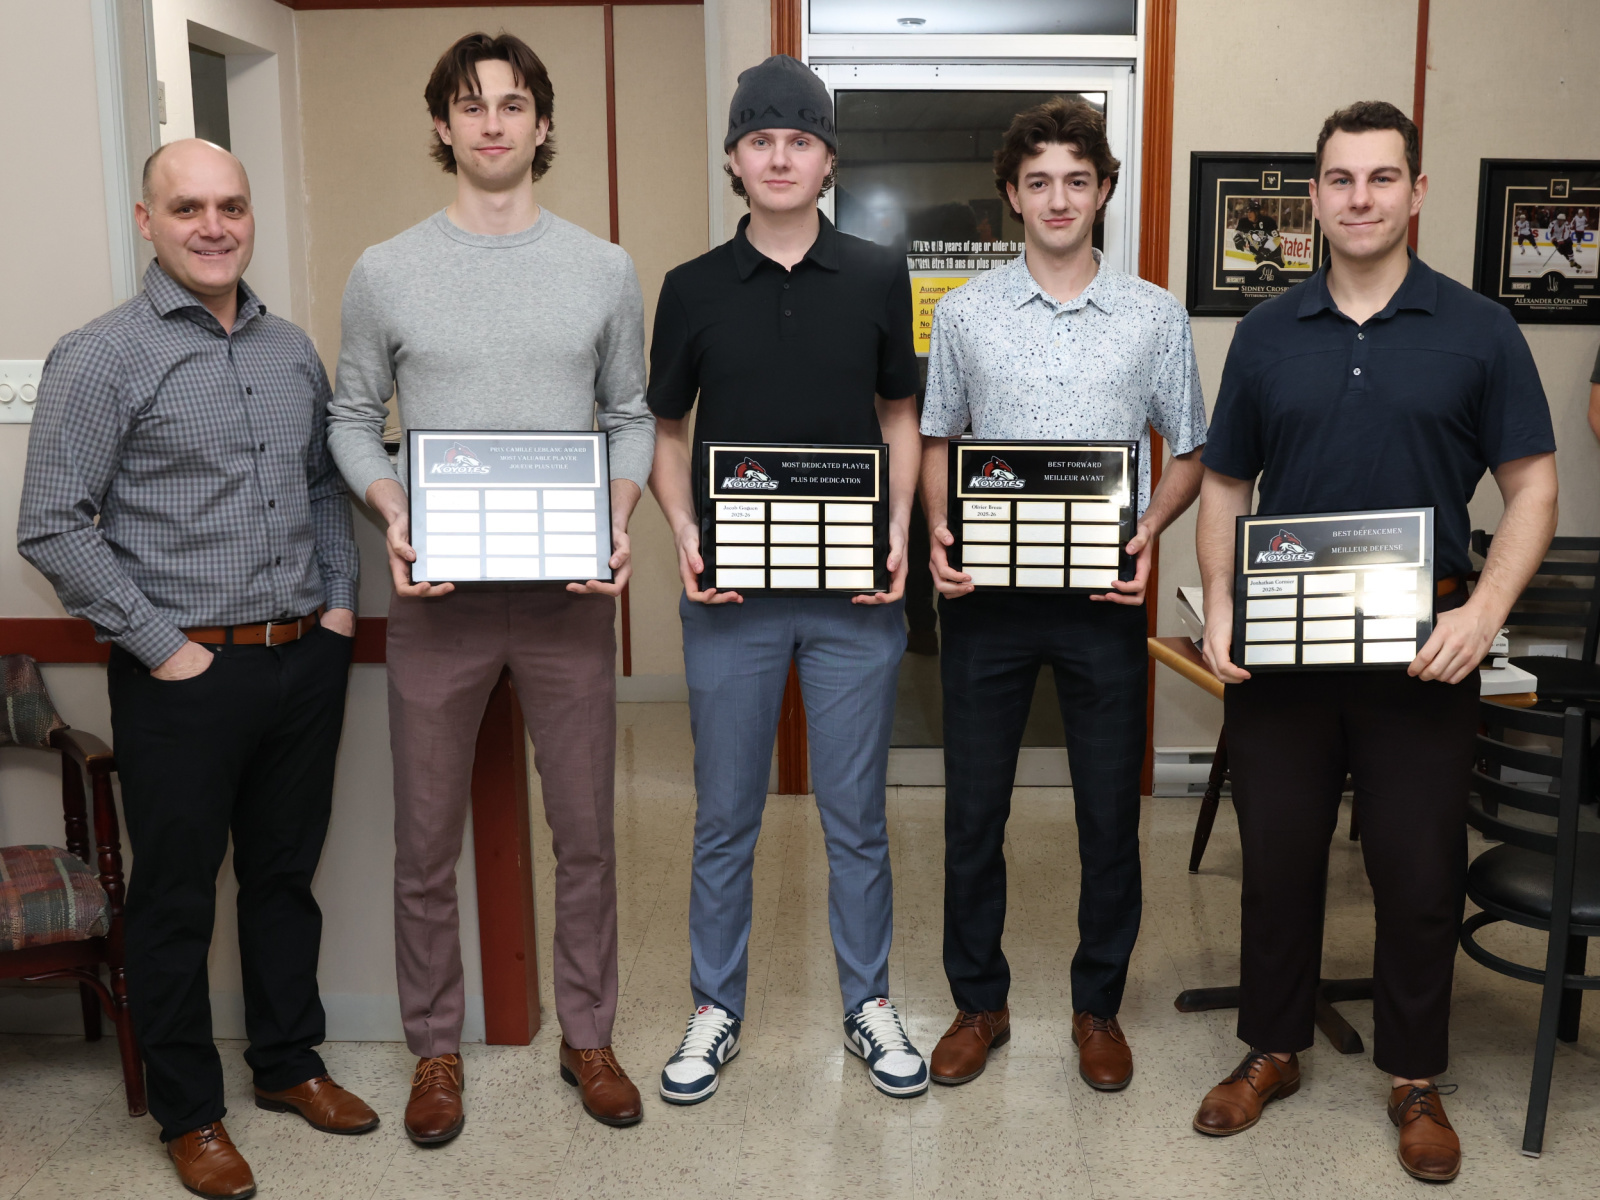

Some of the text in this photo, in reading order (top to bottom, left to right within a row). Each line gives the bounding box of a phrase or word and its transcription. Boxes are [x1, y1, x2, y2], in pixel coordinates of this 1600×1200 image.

[944, 242, 962, 254] years
[963, 240, 970, 252] of
[971, 242, 982, 254] age
[983, 242, 991, 252] or
[992, 240, 1008, 252] older
[1010, 240, 1016, 252] to
[1017, 242, 1026, 251] en
[946, 257, 953, 269] 19
[955, 259, 966, 269] ans
[968, 259, 975, 269] ou
[977, 257, 989, 270] plus
[431, 463, 491, 474] KOYOTES
[721, 477, 779, 490] KOYOTES
[968, 476, 1026, 489] KOYOTES
[1255, 551, 1316, 563] KOYOTES
